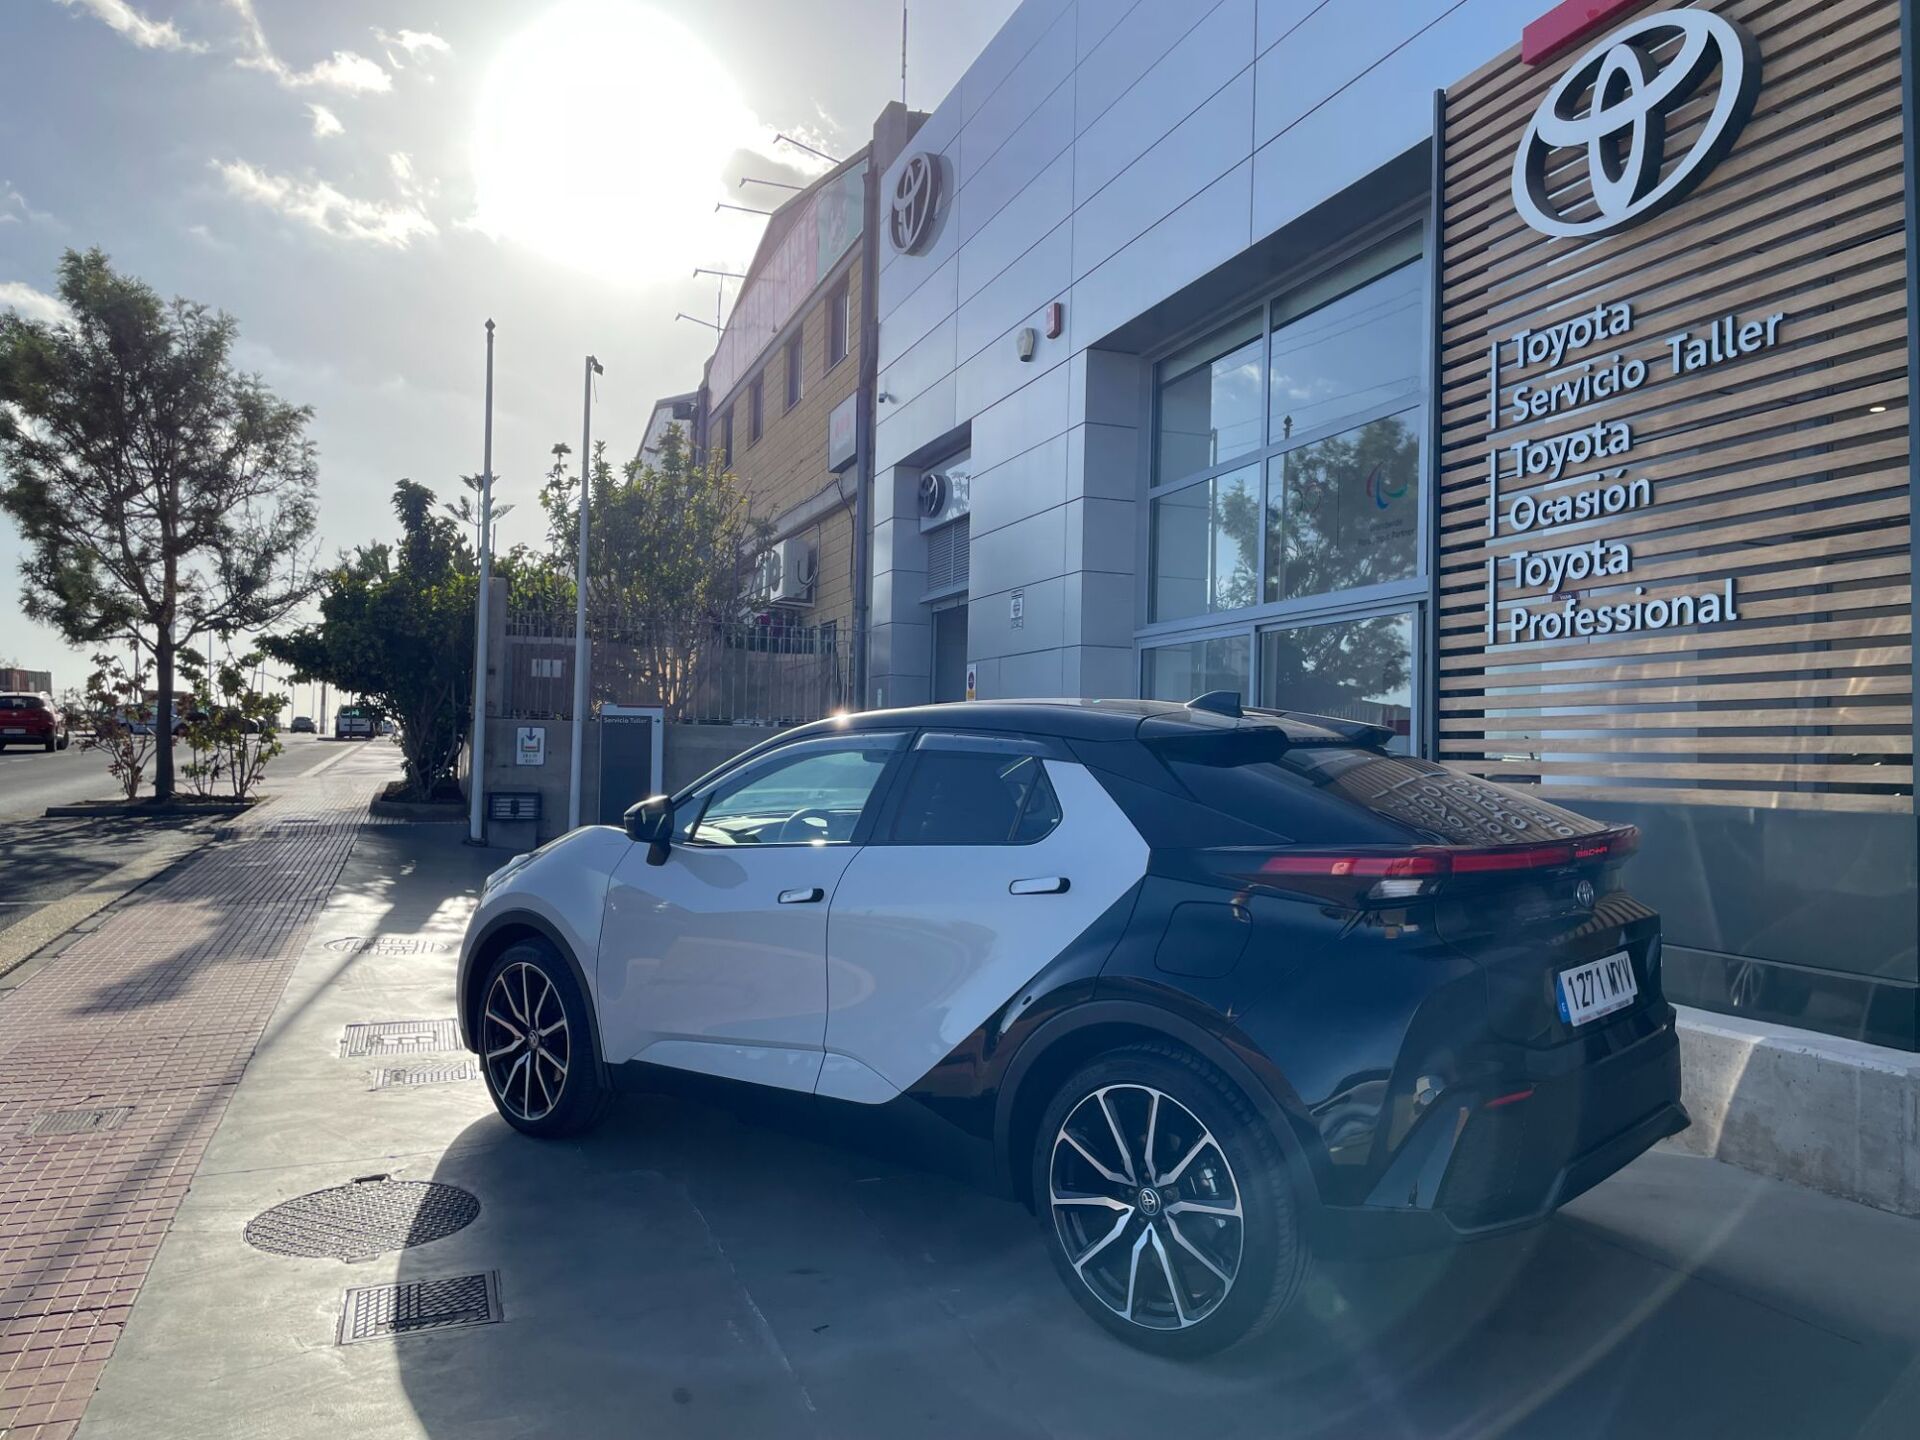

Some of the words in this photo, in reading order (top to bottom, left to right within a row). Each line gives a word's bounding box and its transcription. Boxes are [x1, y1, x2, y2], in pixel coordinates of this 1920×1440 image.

[1510, 303, 1633, 369] Toyota
[1512, 355, 1647, 422] Servicio
[1665, 311, 1785, 375] Taller
[1510, 421, 1631, 480] Toyota
[1509, 469, 1651, 531] Ocasión
[1510, 541, 1631, 595] Toyota
[1510, 578, 1738, 642] Professional
[1568, 966, 1606, 1011] 1271
